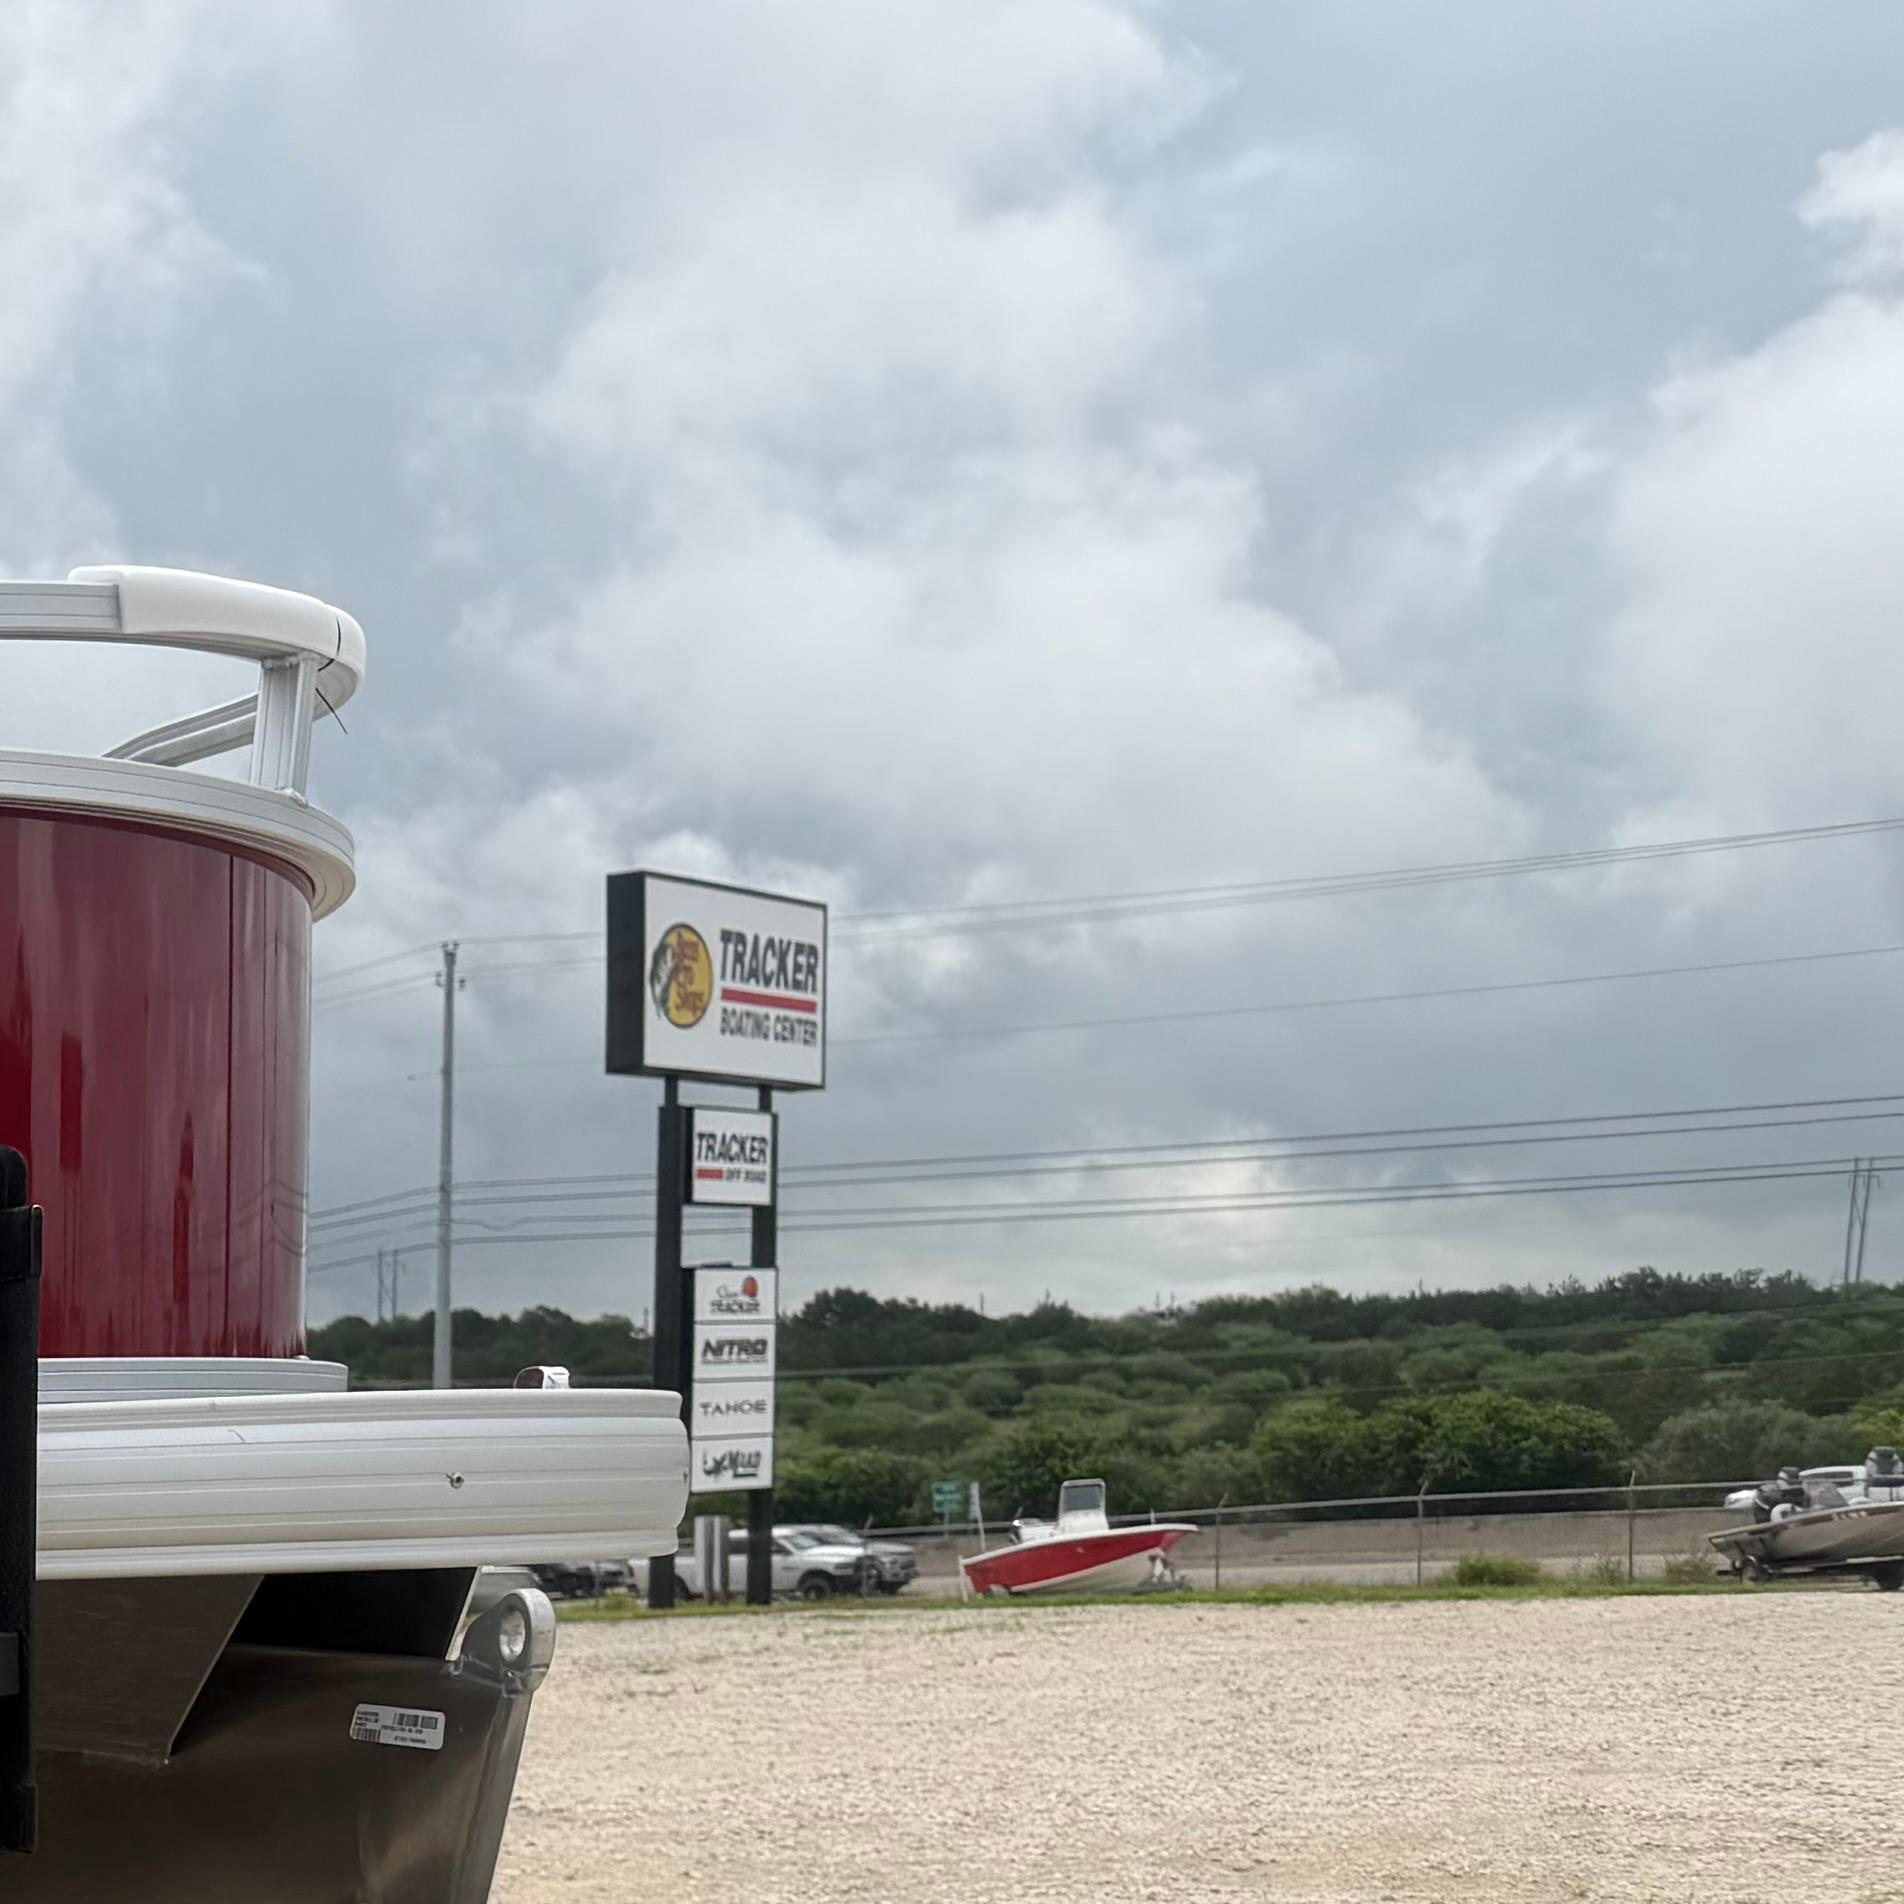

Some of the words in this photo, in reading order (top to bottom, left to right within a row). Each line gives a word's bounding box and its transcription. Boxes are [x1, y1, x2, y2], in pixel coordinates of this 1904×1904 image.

[720, 928, 819, 995] TRACKER
[720, 1007, 770, 1042] BOATING
[773, 1015, 818, 1048] CENTER
[696, 1132, 769, 1165] TRACKER
[702, 1338, 768, 1358] NITRO
[699, 1399, 767, 1416] TAHOE
